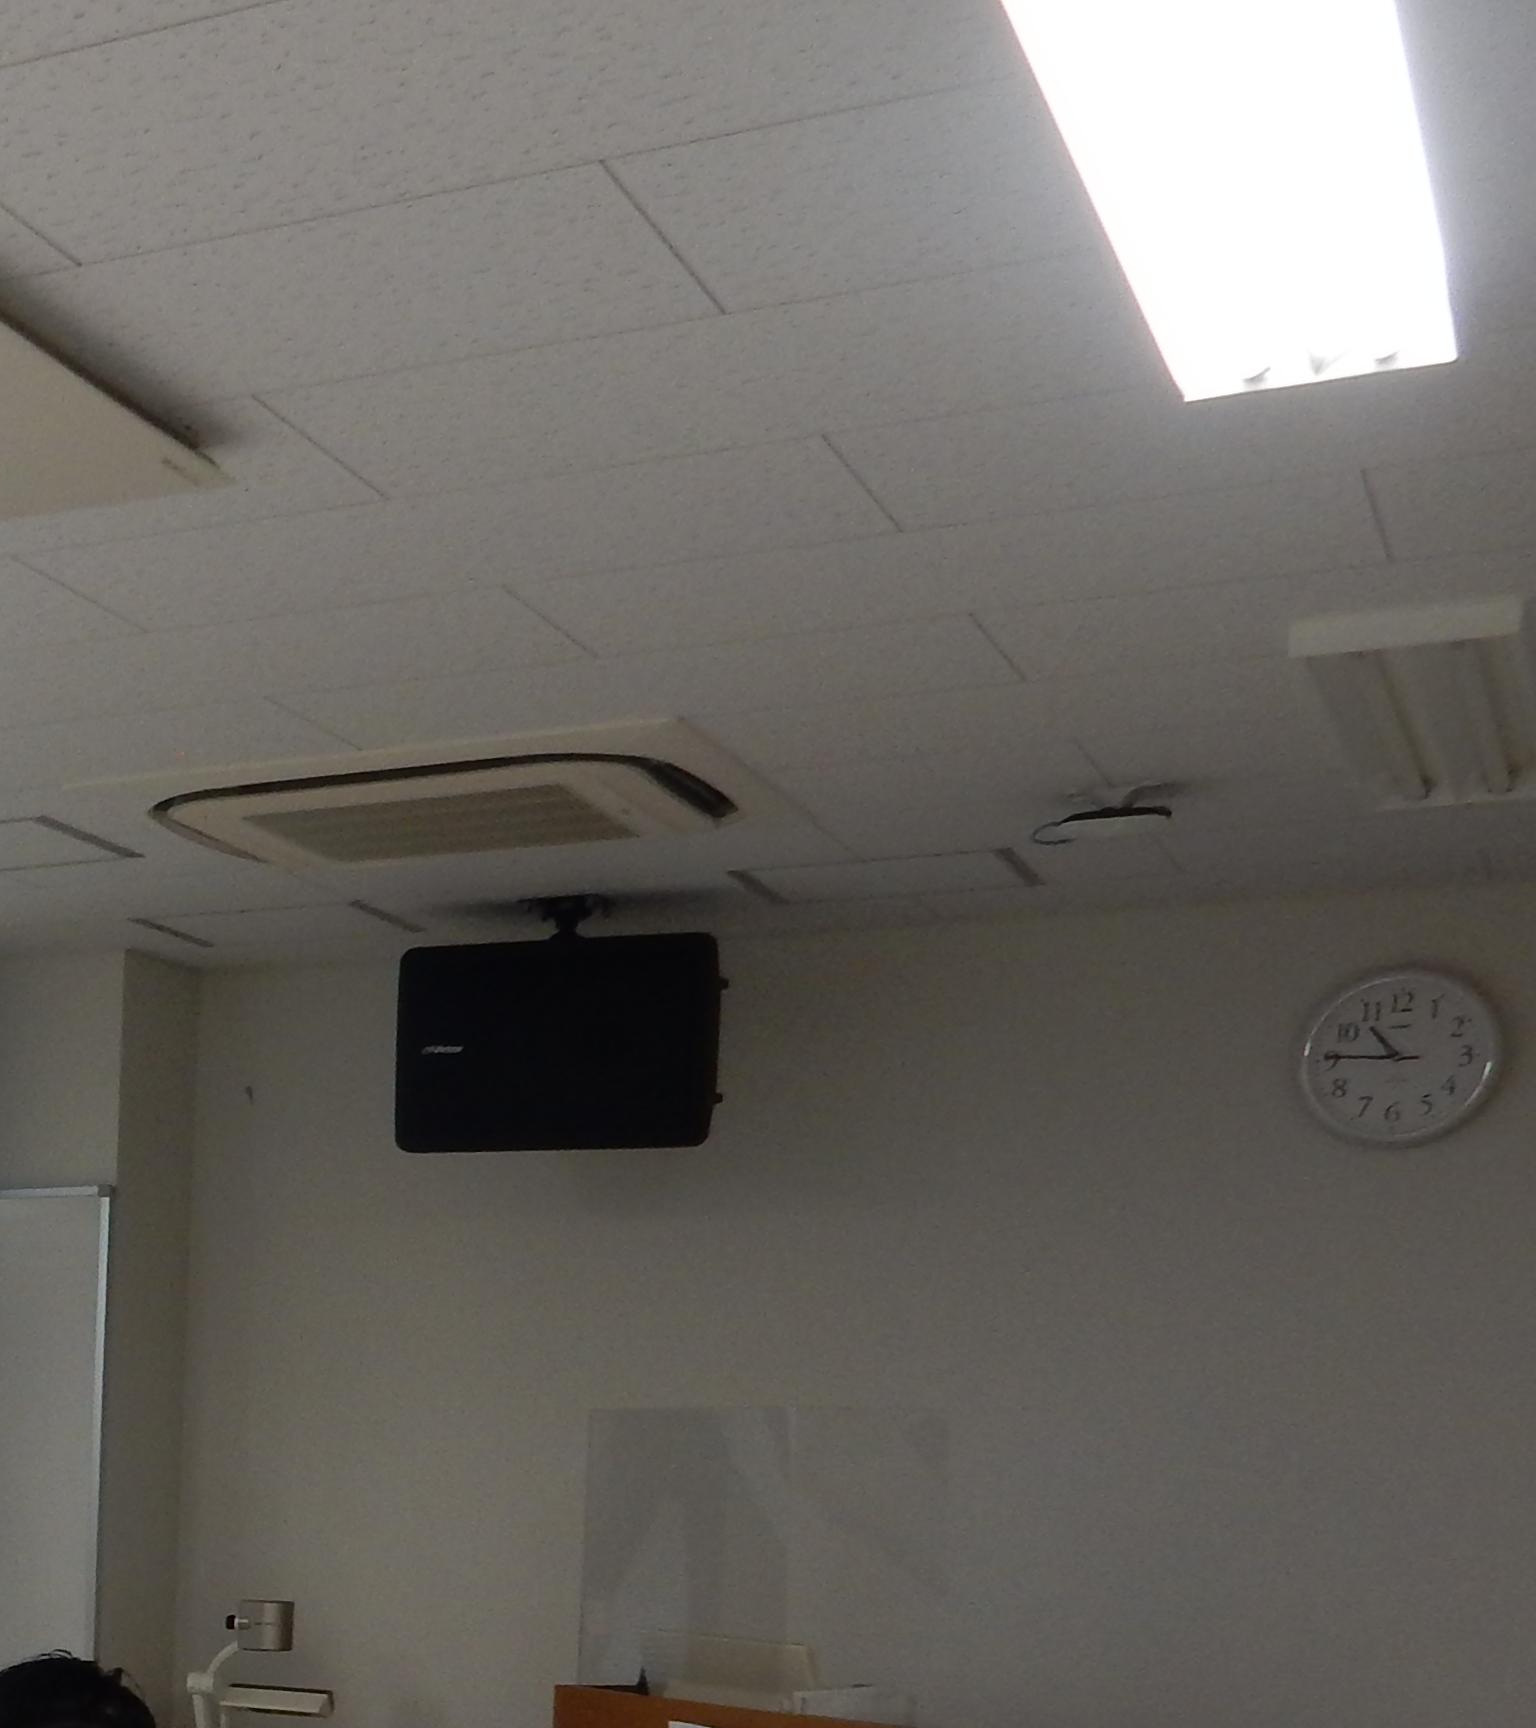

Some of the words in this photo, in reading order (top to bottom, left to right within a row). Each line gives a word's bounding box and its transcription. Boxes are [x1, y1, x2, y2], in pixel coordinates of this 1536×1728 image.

[1361, 1001, 1381, 1022] 11
[1391, 991, 1414, 1014] 12
[1337, 1022, 1360, 1043] 10
[1450, 1016, 1465, 1038] 2
[1458, 1044, 1473, 1068] 3
[1331, 1078, 1347, 1098] 8
[1441, 1074, 1456, 1096] 4
[1358, 1095, 1374, 1118] 7
[1383, 1102, 1400, 1122] 6
[1420, 1093, 1433, 1116] 5
